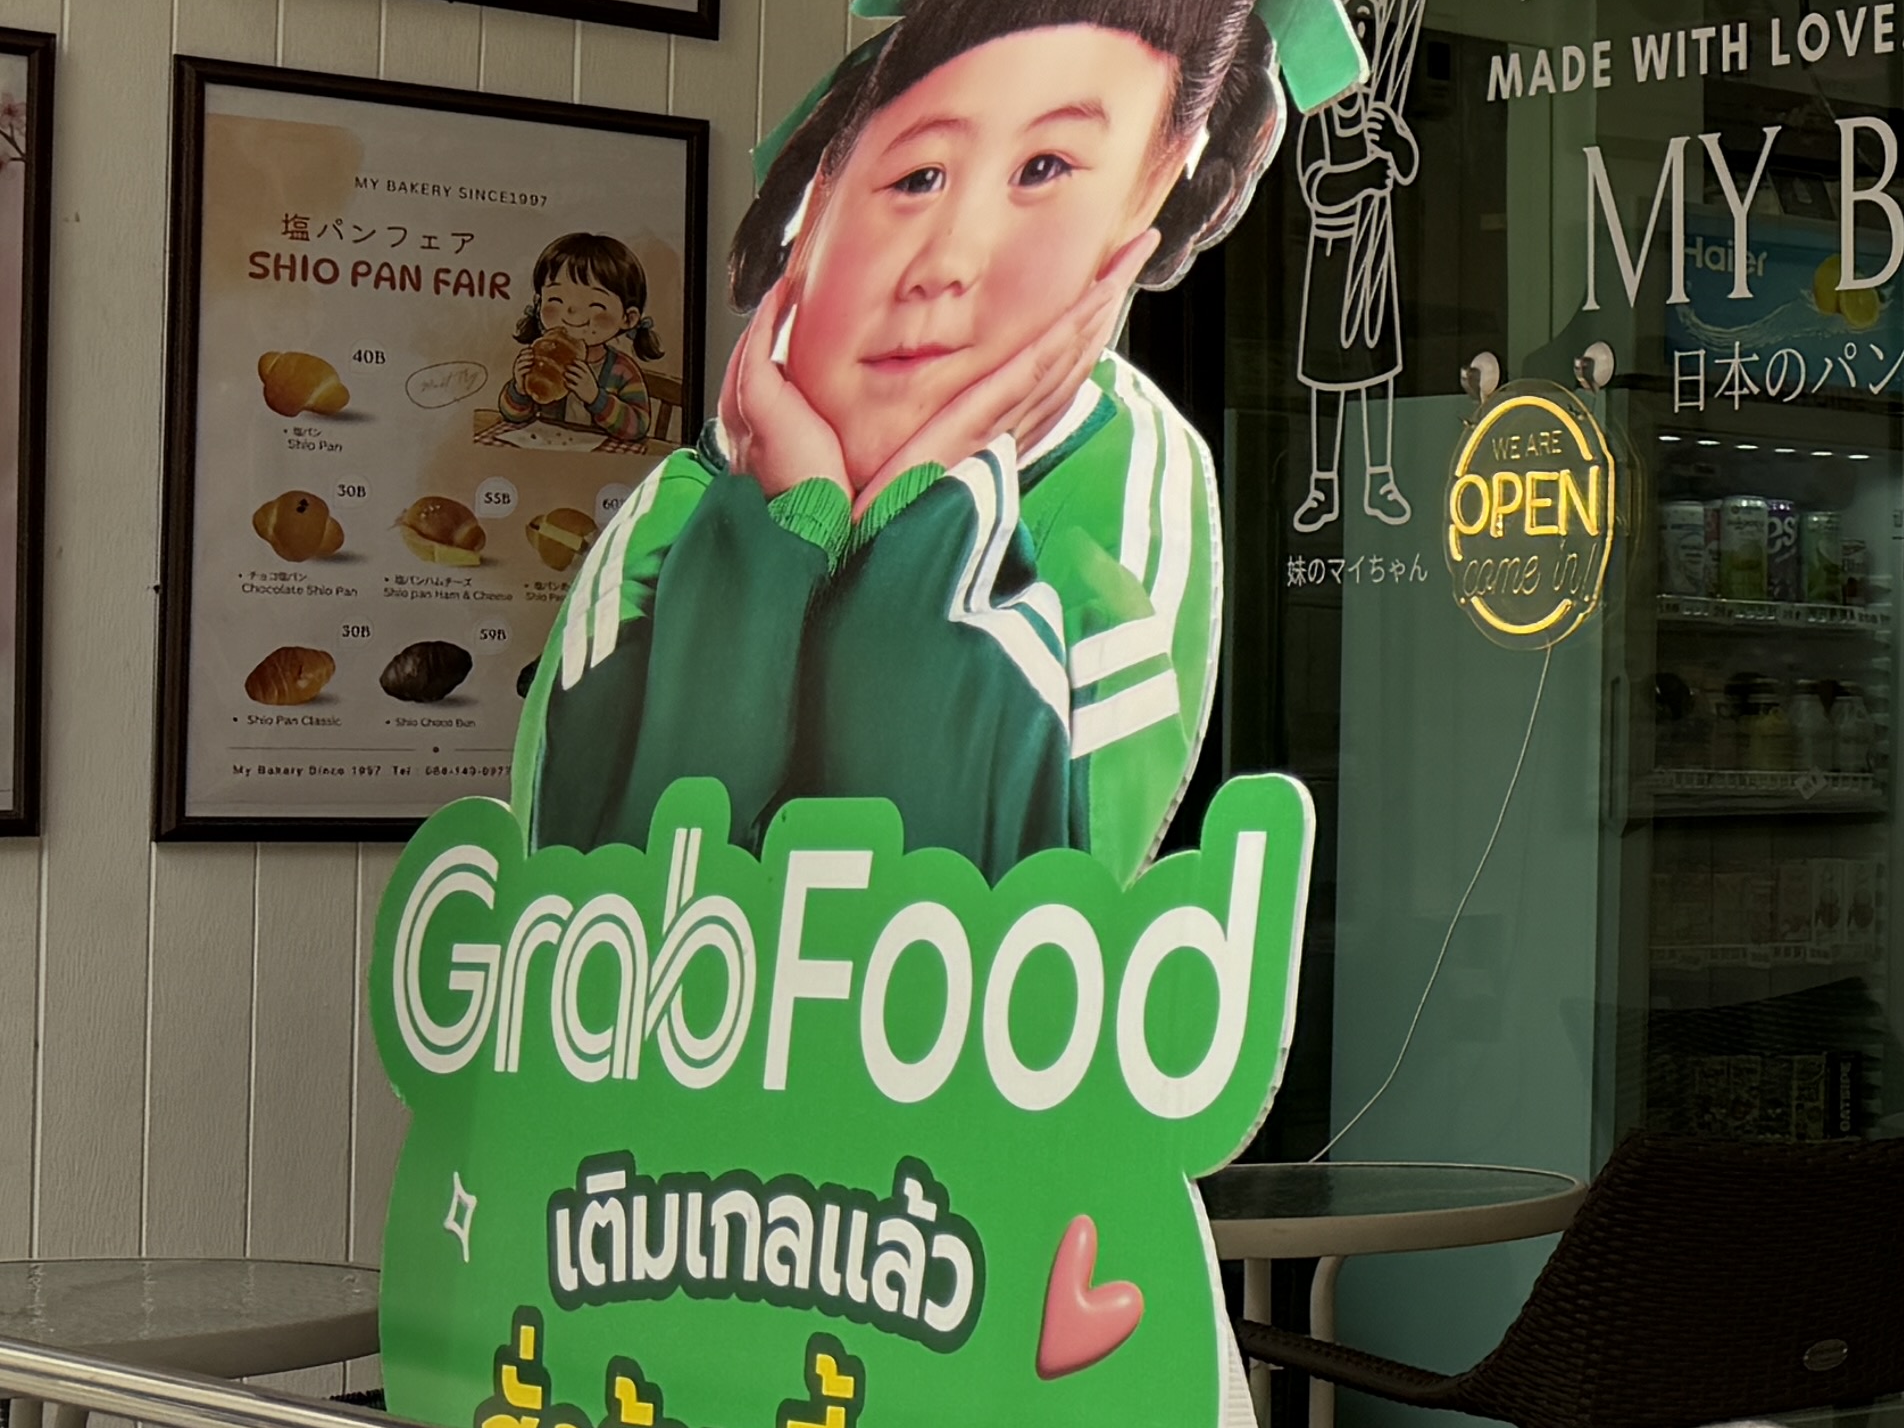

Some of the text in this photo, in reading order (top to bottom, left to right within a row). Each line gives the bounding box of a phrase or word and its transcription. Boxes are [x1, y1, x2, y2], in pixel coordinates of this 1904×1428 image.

[1487, 37, 1610, 103] MADE
[1632, 20, 1749, 83] WITH
[354, 177, 547, 207] MY BAKERY SINCE1997
[281, 212, 475, 254] 塩パンフェア
[1583, 126, 1782, 312] MY
[249, 251, 511, 300] SHIO PAN FAIR
[353, 349, 386, 365] 40B
[1492, 431, 1562, 460] WE ARE
[337, 484, 366, 498] 30B
[484, 491, 511, 505] 55B
[1450, 466, 1599, 537] OPEN
[1287, 553, 1428, 587] 妹のマイちゃん
[1463, 555, 1541, 595] come
[393, 827, 1267, 1119] GrabFood
[556, 1170, 974, 1332] เติมเกลแล้ว
